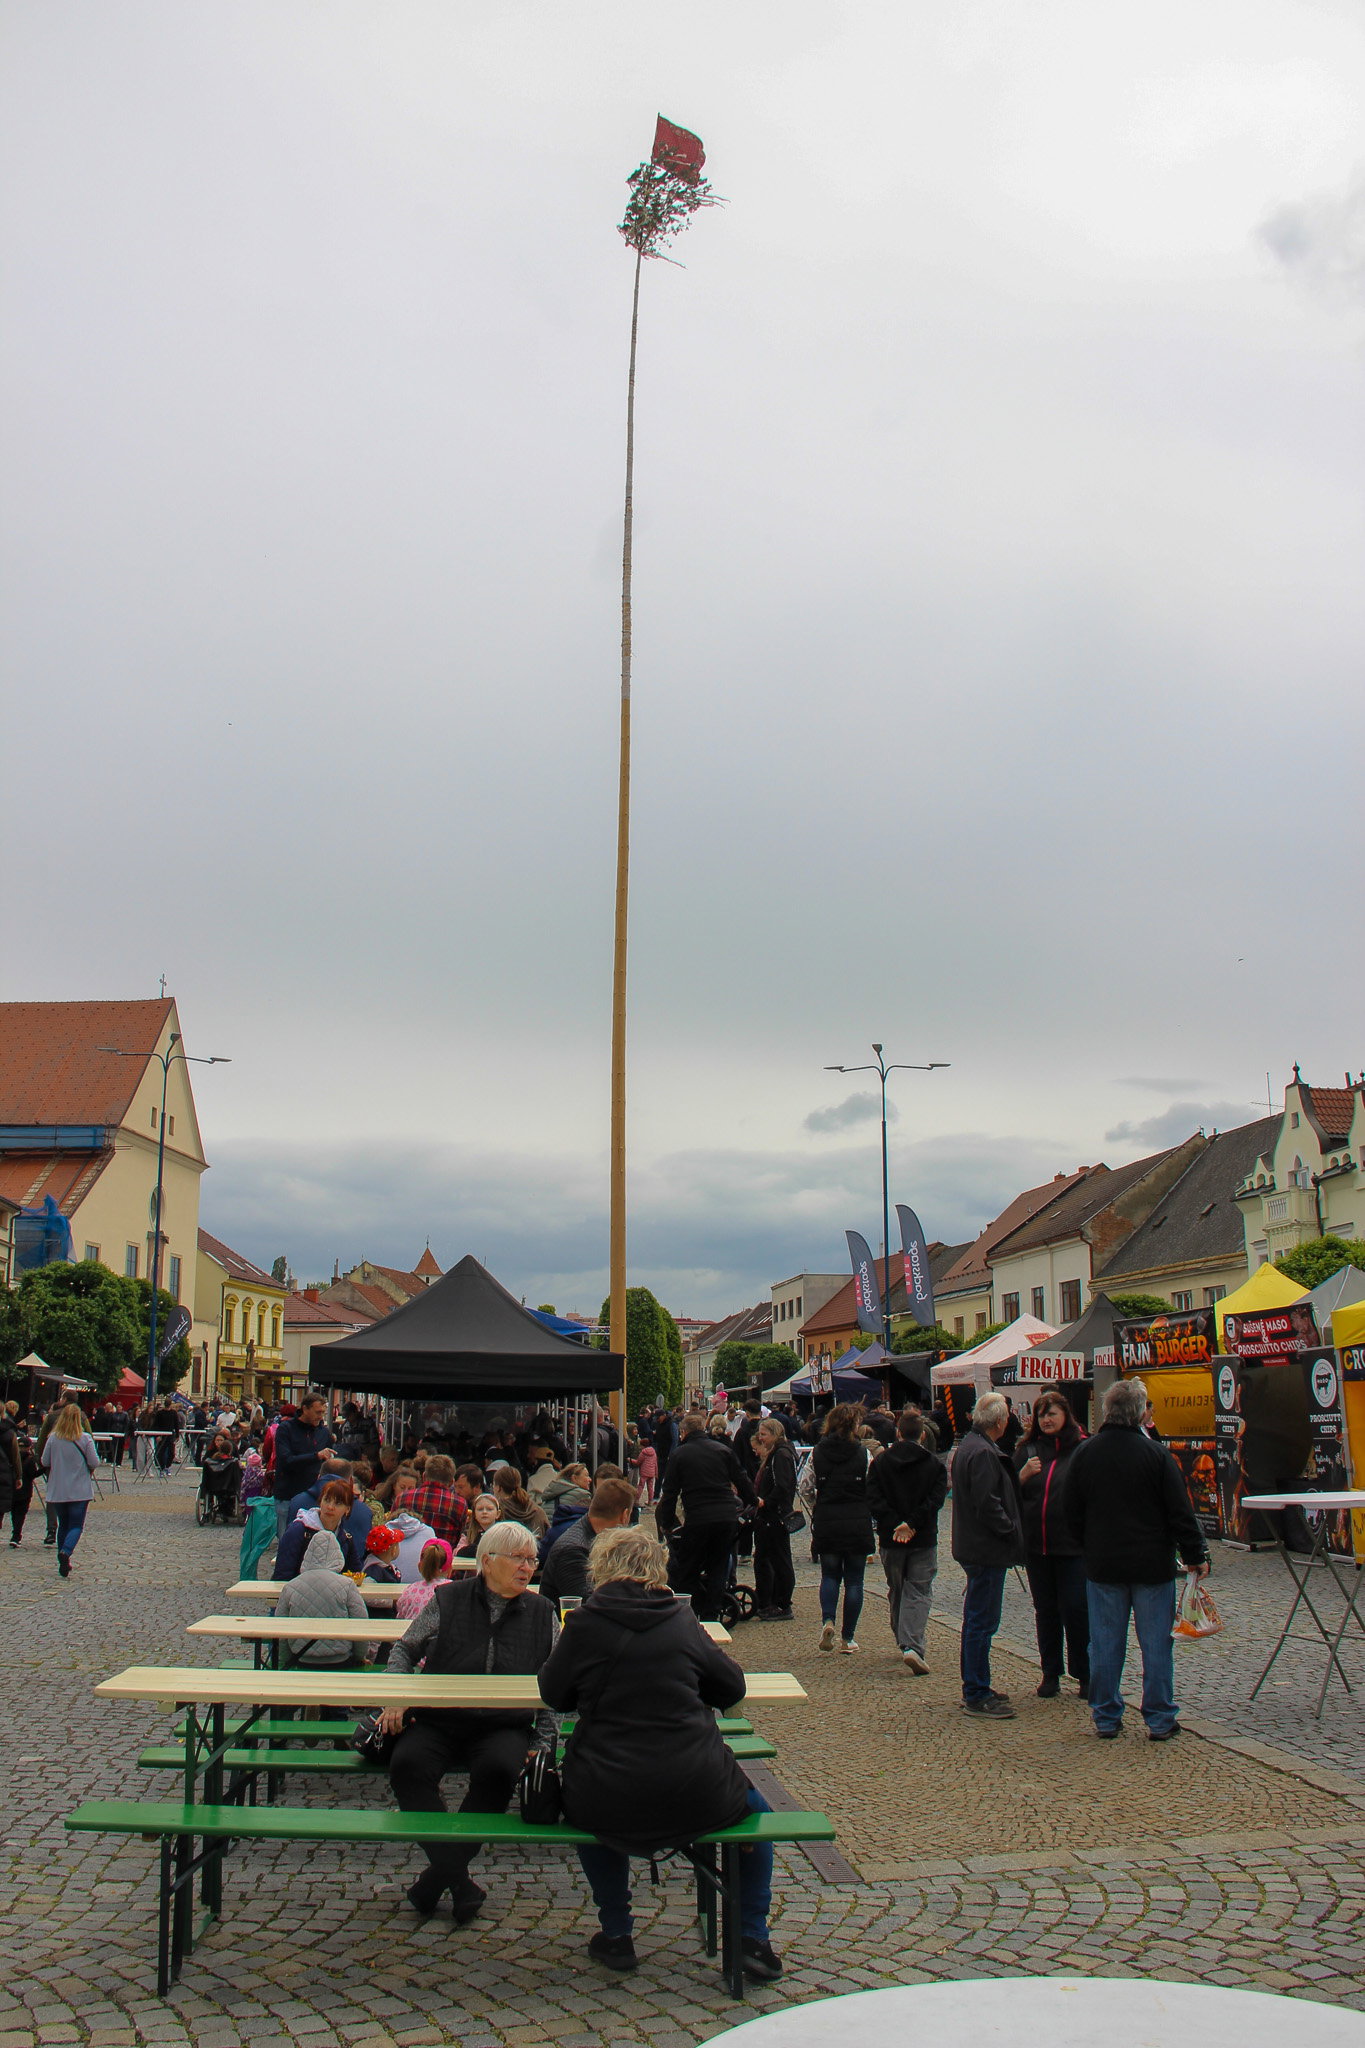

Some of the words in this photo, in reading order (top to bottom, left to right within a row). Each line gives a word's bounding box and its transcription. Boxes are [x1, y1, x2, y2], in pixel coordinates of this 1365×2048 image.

[1265, 1318, 1288, 1332] MASO
[1121, 1342, 1151, 1368] FAJN
[1155, 1335, 1212, 1365] BURGER
[1238, 1342, 1280, 1355] PROSCIUTTO
[1280, 1339, 1307, 1352] CHIPS
[1020, 1354, 1081, 1379] FRGÁLY
[1309, 1412, 1342, 1423] PROSCIUTT
[1320, 1425, 1337, 1434] CHIPS
